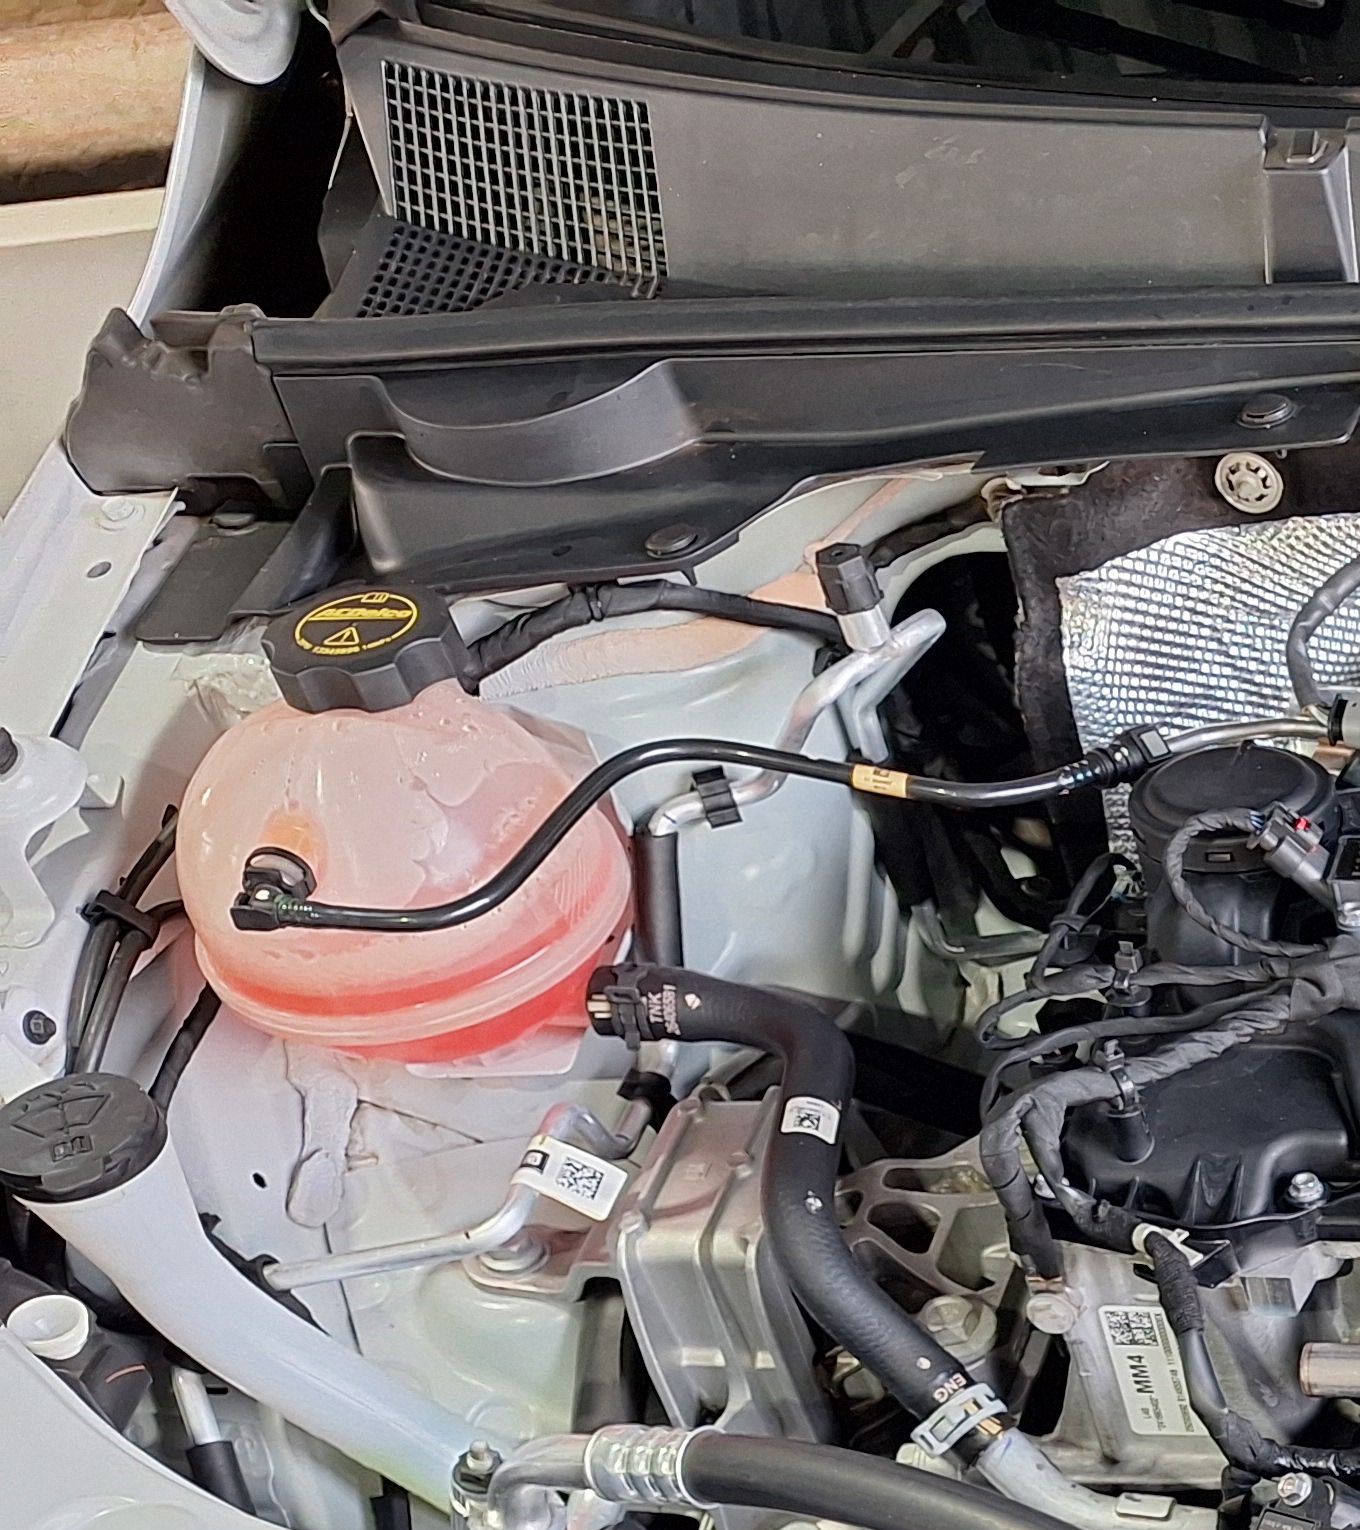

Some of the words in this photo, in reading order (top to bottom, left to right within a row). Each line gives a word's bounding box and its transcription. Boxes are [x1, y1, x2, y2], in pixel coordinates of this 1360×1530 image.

[647, 991, 664, 1024] TNK
[932, 1372, 968, 1404] ENG
[1126, 1354, 1155, 1394] MM4
